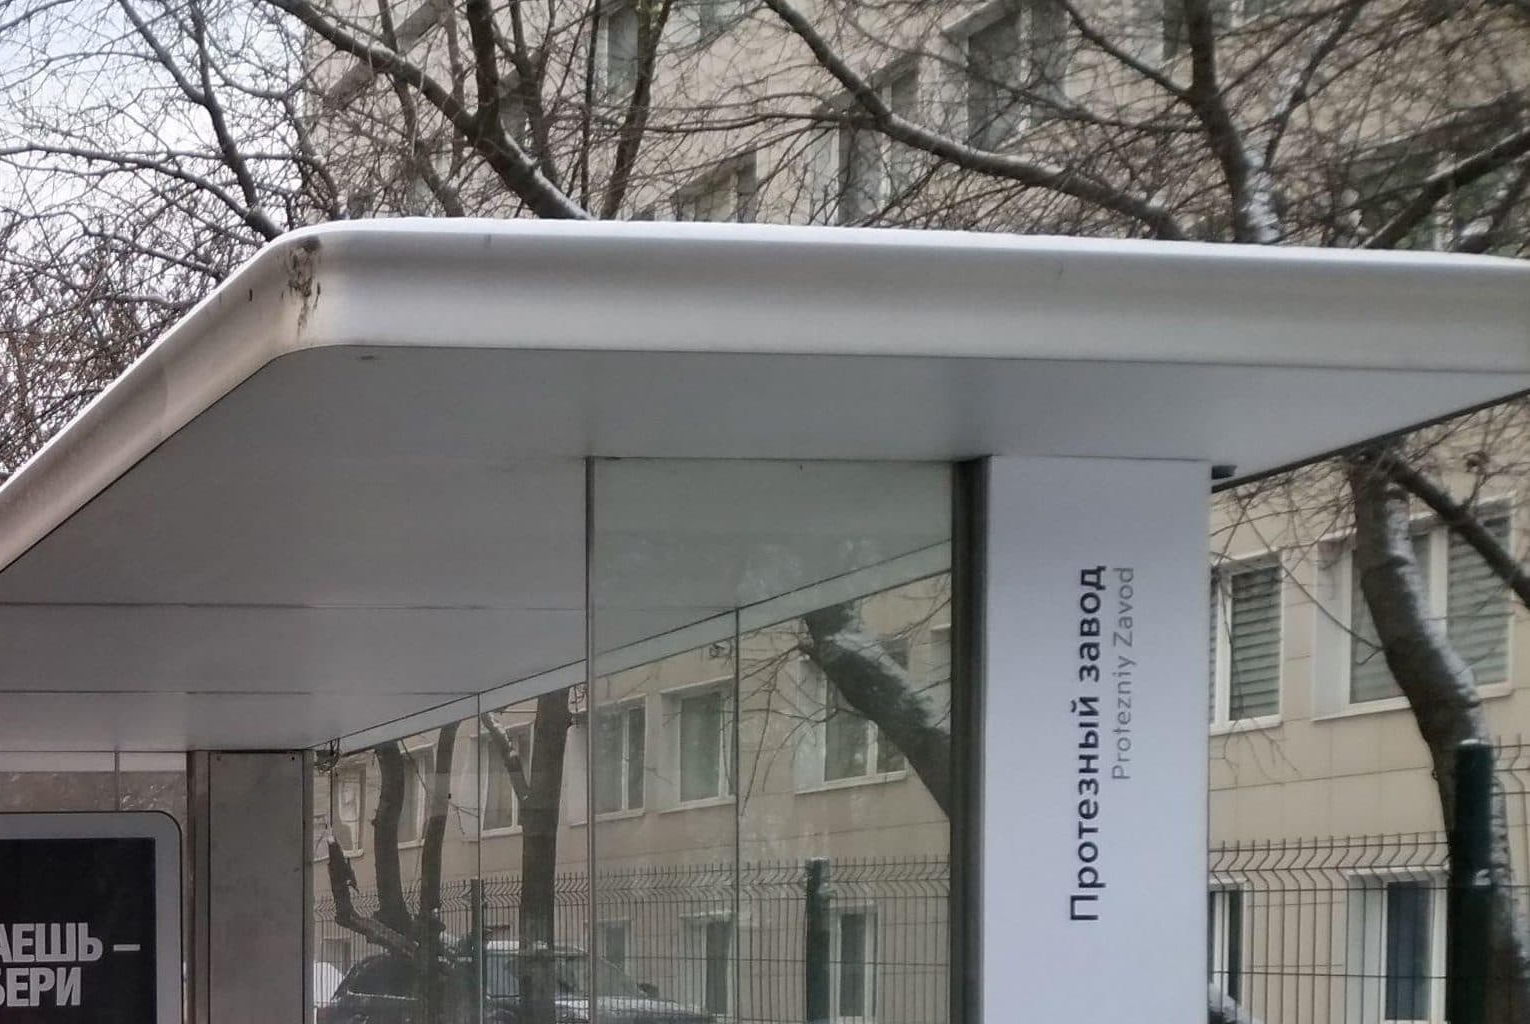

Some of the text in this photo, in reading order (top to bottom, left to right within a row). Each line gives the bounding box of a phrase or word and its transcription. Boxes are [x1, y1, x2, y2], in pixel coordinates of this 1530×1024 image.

[1070, 566, 1107, 921] Протезный завод
[1112, 567, 1136, 780] Protezniy Zavod
